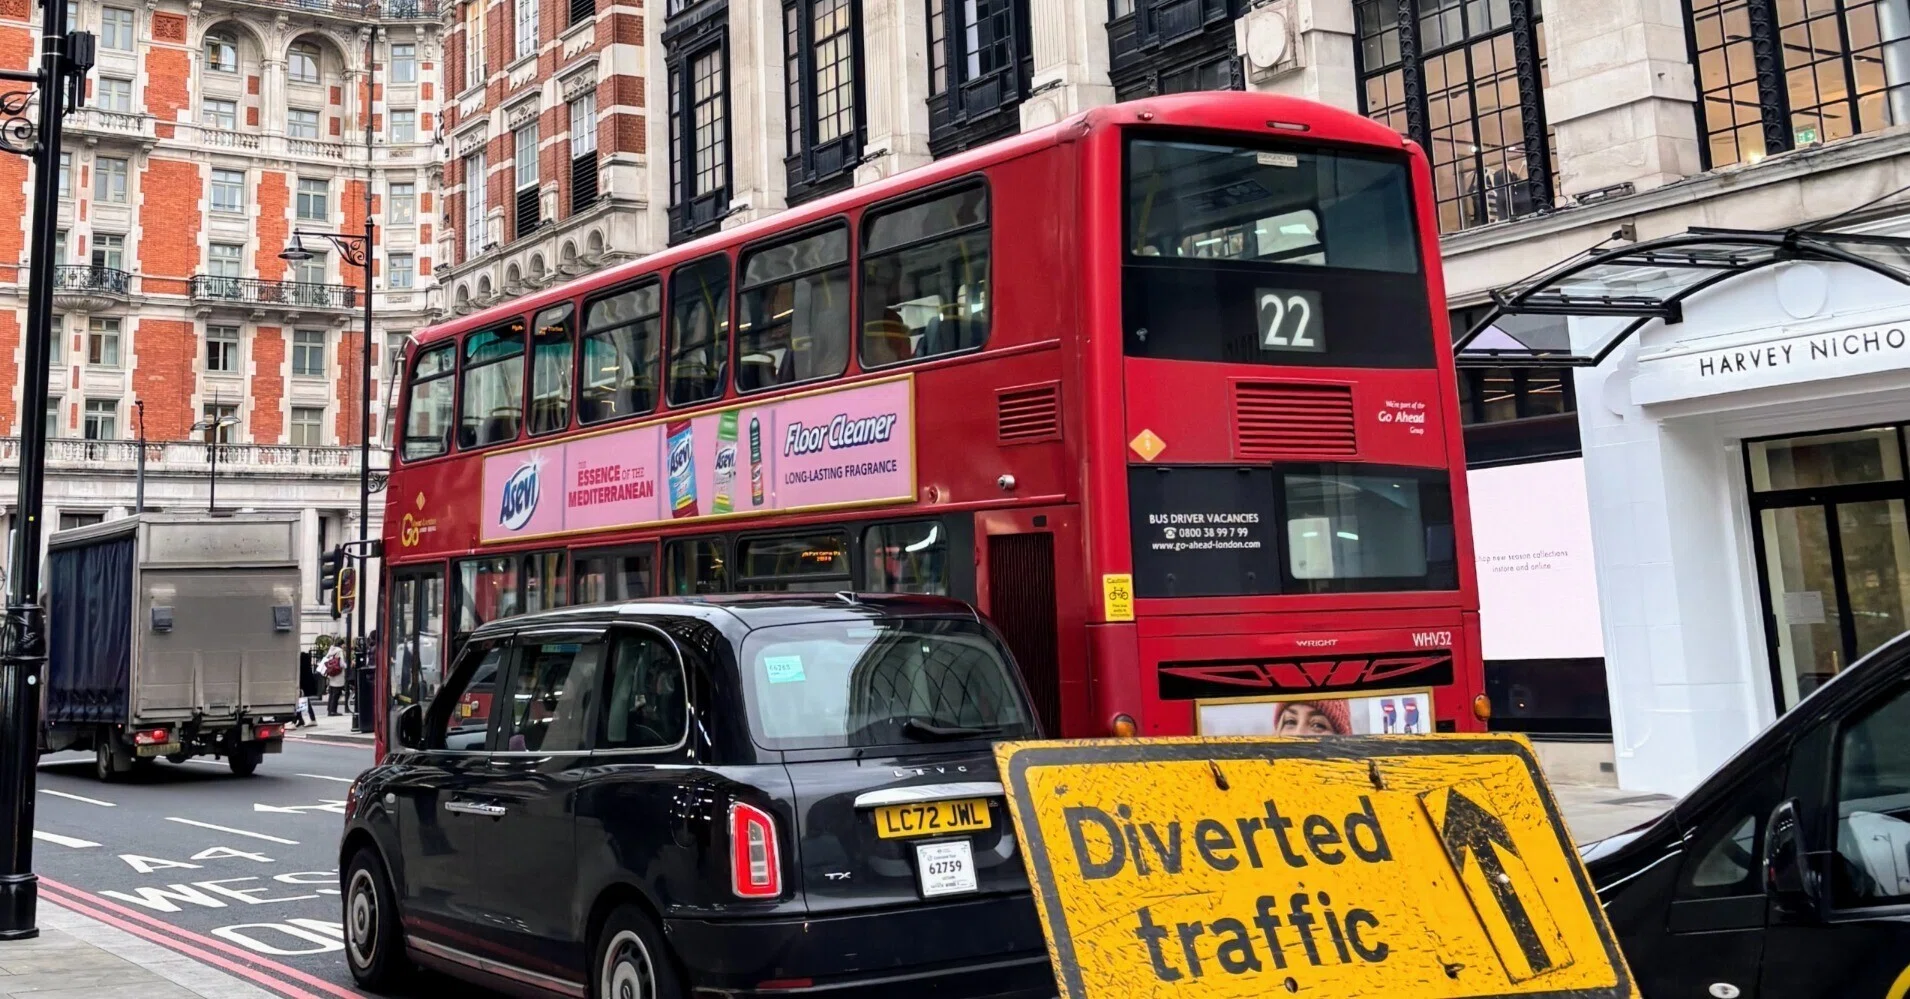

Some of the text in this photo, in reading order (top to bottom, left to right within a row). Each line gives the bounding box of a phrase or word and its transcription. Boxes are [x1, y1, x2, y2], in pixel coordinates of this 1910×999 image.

[1261, 294, 1314, 347] 22
[1699, 328, 1905, 377] HARVEY NICHO
[1378, 410, 1425, 423] Go Ahead
[784, 413, 897, 457] Floor Cleaner
[577, 465, 645, 487] ESSENCE OF THE
[785, 460, 898, 484] LONG-LASTING FRAGRANCE
[499, 464, 537, 525] Asevi
[568, 480, 654, 508] MEDITERRANEAN
[1149, 513, 1259, 524] BUS DRIVER VACANCIES
[1179, 528, 1248, 538] 0800 38 99 7 99
[1152, 541, 1261, 551] www.go-ahead-london.com
[1533, 550, 1568, 559] collections
[1515, 562, 1529, 571] and
[1296, 639, 1339, 647] WRIGHT
[1412, 632, 1452, 646] WHV32
[885, 803, 984, 833] LC72 JWL
[1063, 795, 1393, 880] Diverted
[118, 847, 276, 873] A4
[929, 860, 962, 875] 62759
[824, 871, 851, 880] TX
[1135, 890, 1389, 982] traffic
